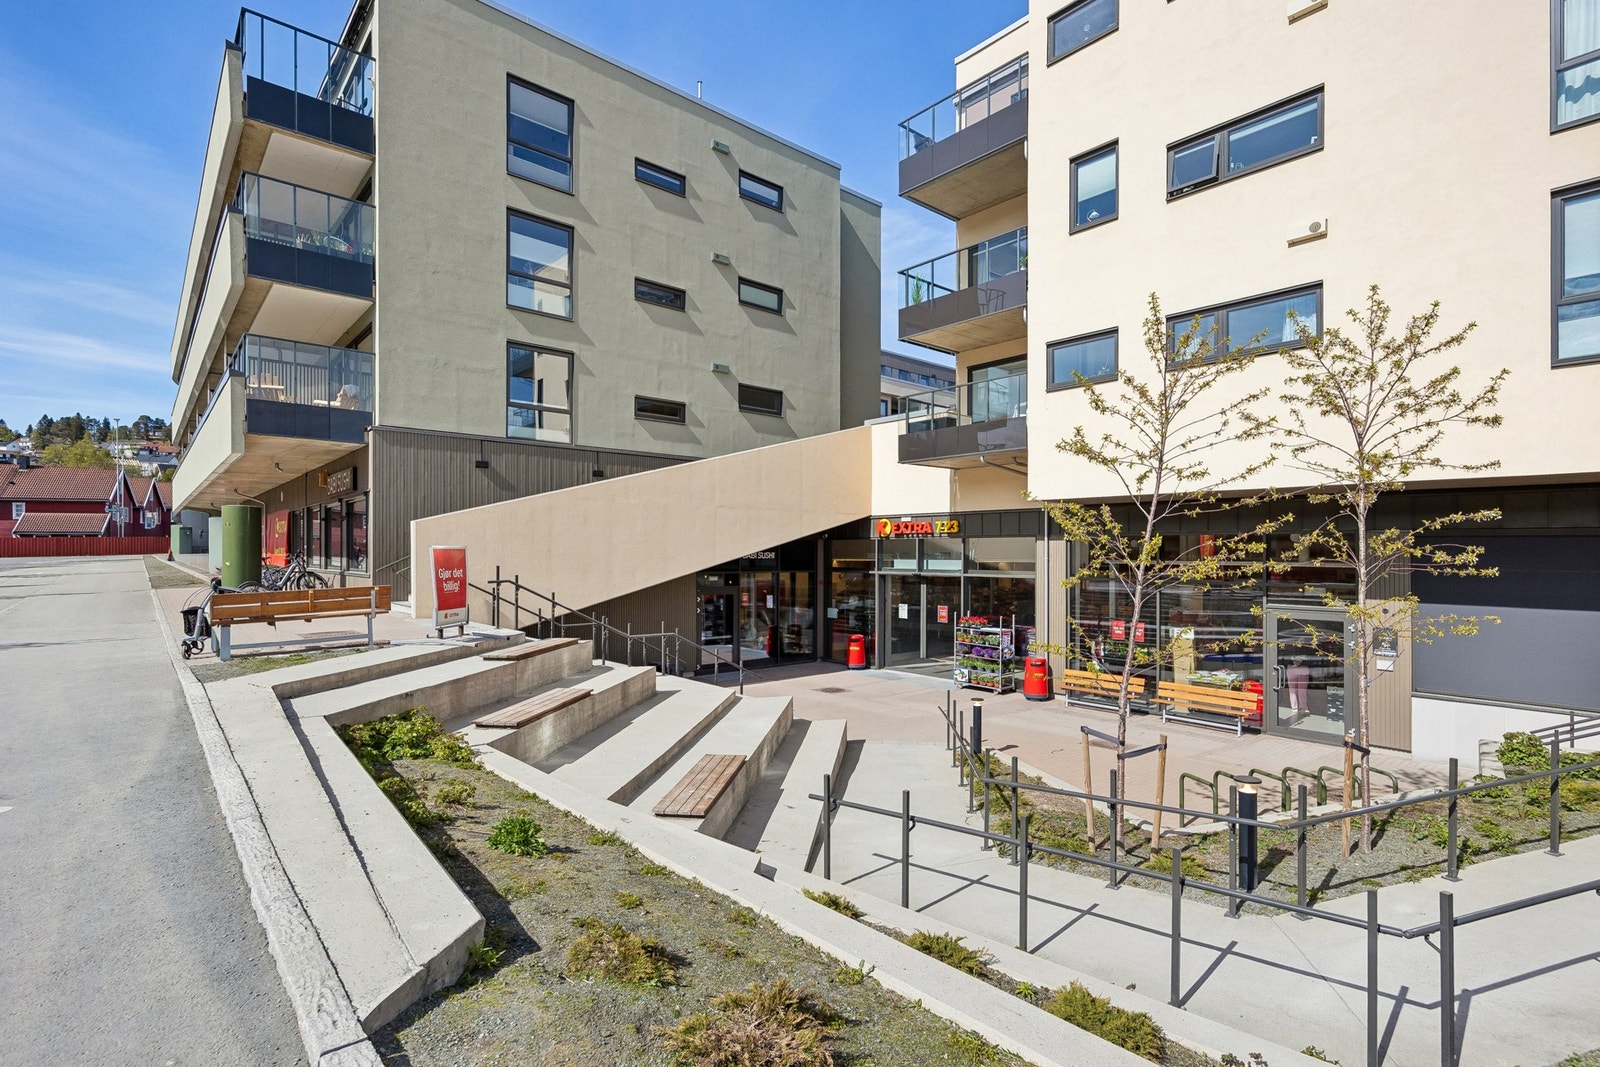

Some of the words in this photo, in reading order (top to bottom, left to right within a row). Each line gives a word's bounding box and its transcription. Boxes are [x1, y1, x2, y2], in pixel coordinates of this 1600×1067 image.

[892, 521, 933, 534] EXTRA
[935, 520, 958, 533] 7-23
[758, 551, 775, 559] SUSHI
[438, 568, 452, 580] Gjør
[452, 568, 463, 578] det
[443, 580, 460, 593] billig!
